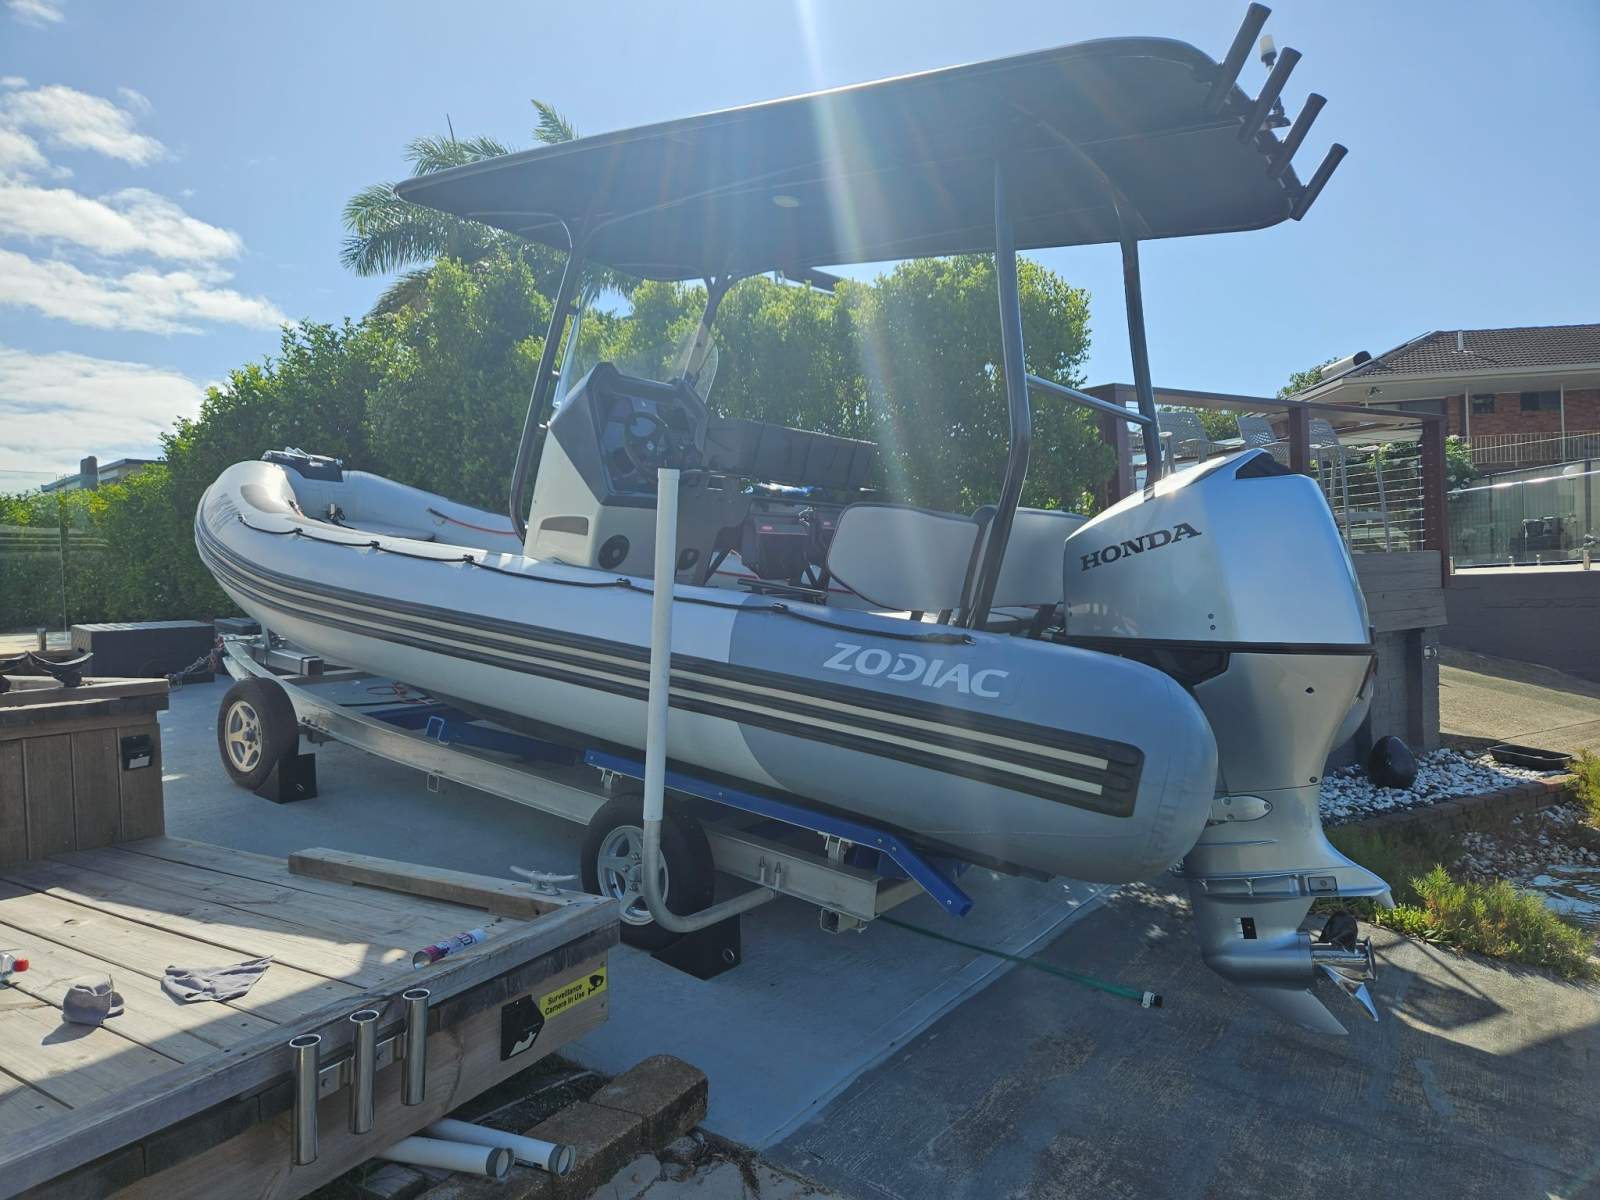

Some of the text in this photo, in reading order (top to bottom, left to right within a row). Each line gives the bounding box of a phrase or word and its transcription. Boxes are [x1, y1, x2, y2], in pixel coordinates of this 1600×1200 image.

[1080, 522, 1202, 572] HONDA
[823, 642, 1010, 698] ZODIAC
[545, 1001, 567, 1015] Camera
[574, 991, 585, 1001] Use
[548, 984, 583, 1005] Surveillance
